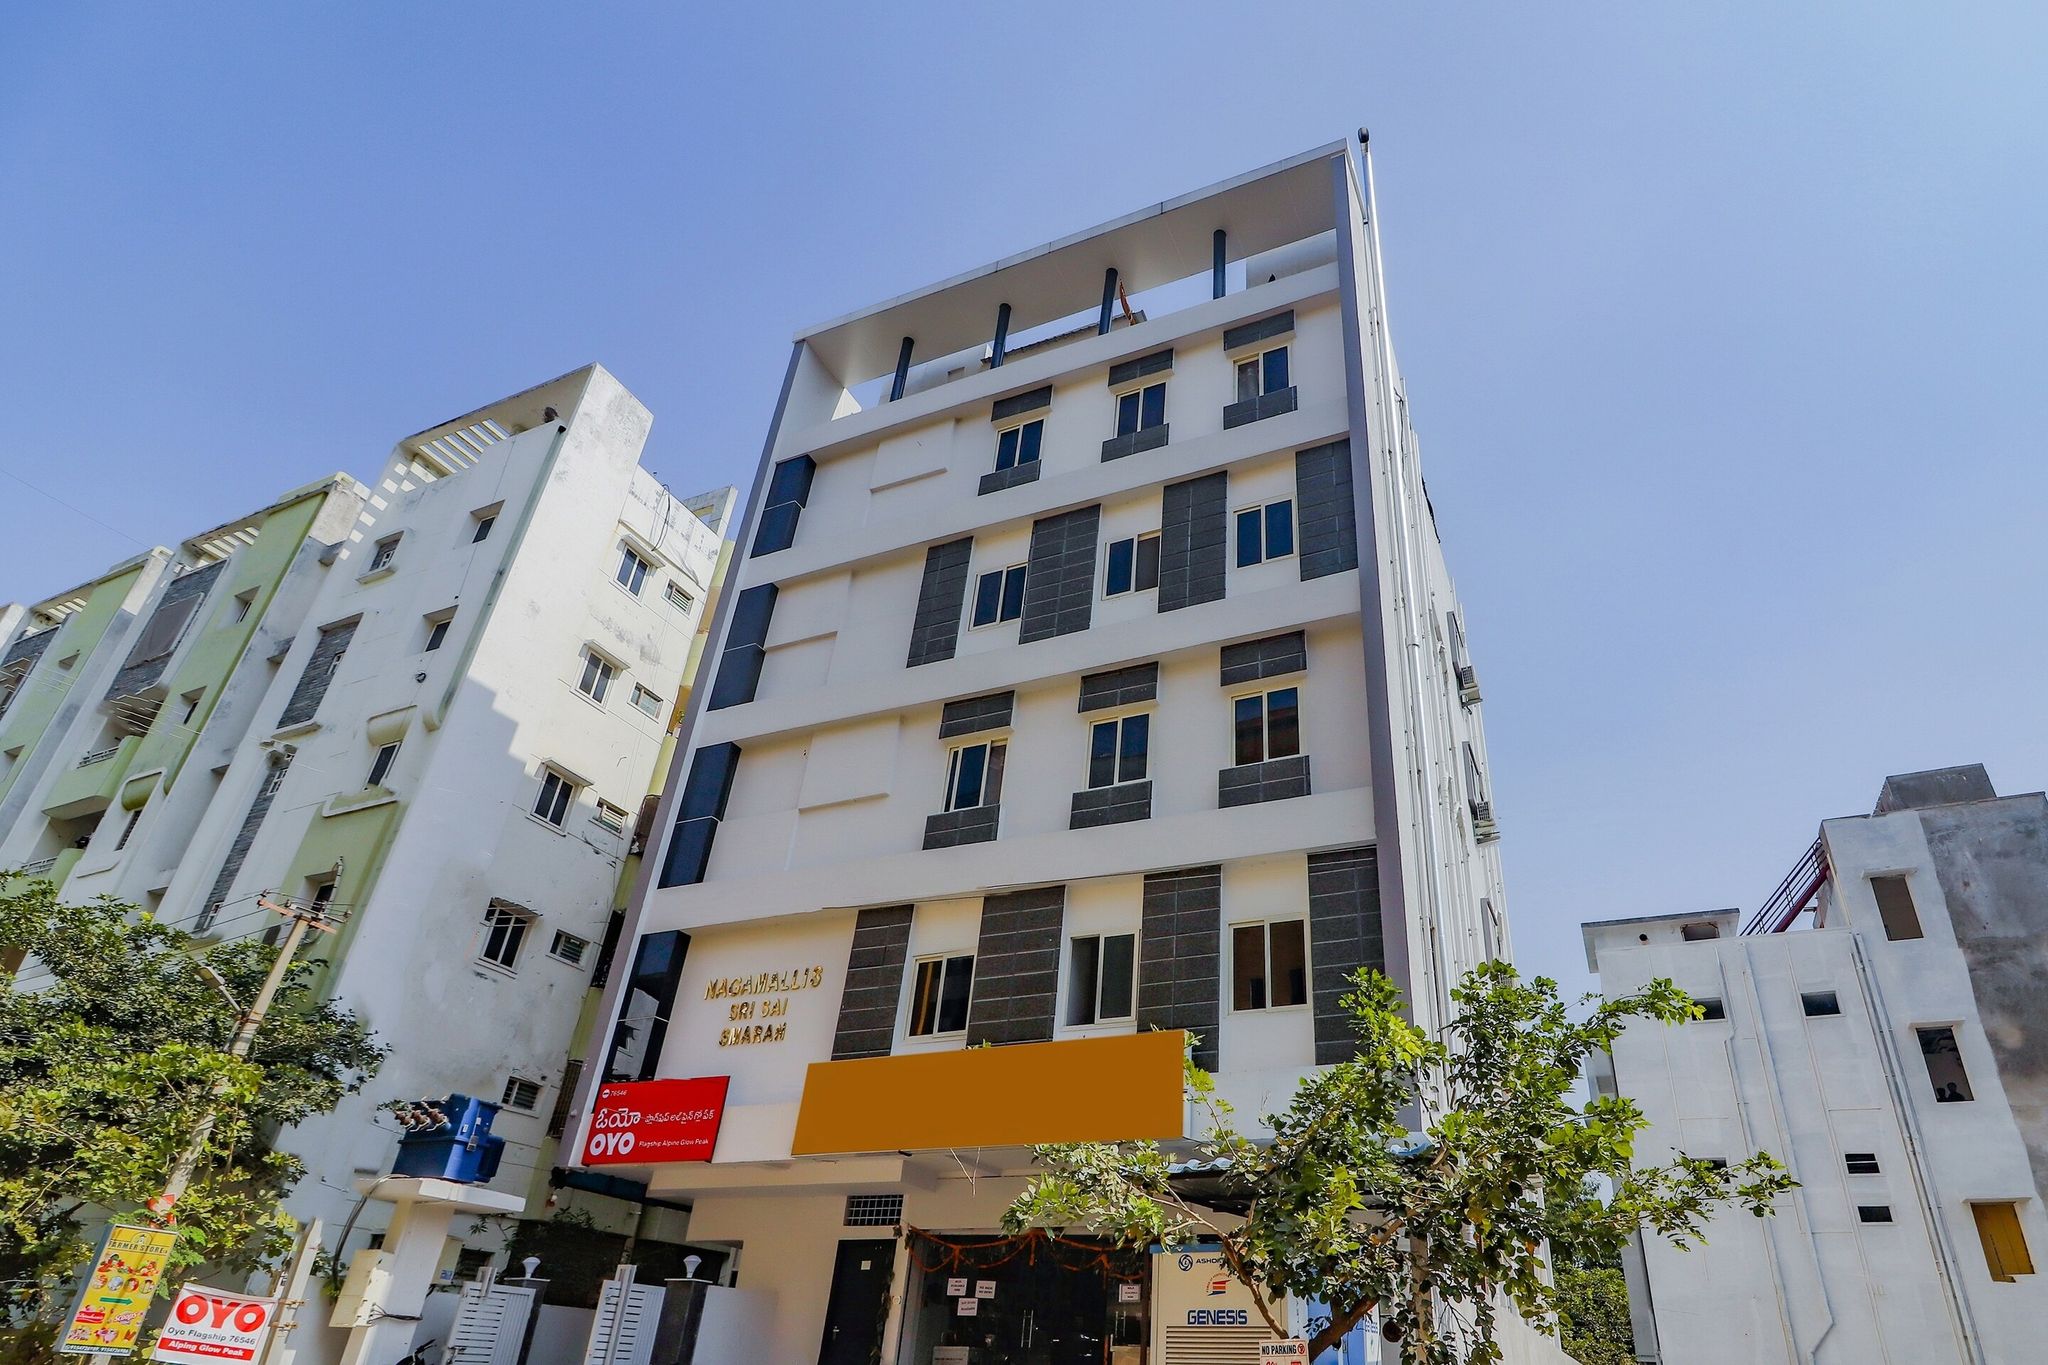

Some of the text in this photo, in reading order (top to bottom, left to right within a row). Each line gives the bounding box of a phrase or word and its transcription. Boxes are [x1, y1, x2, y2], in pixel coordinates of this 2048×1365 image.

[729, 998, 788, 1021] SRI SAI
[596, 1107, 641, 1129] ఓయో
[590, 1131, 635, 1156] OYO
[638, 1140, 662, 1149] Flagship
[695, 1138, 709, 1146] Peak
[176, 1294, 266, 1333] OYO
[1187, 1309, 1248, 1325] GENESIS
[167, 1326, 256, 1345] Oyo Flagship 76546
[168, 1340, 245, 1357] Alping Glow Peak
[1262, 1344, 1297, 1355] NO PARKING
